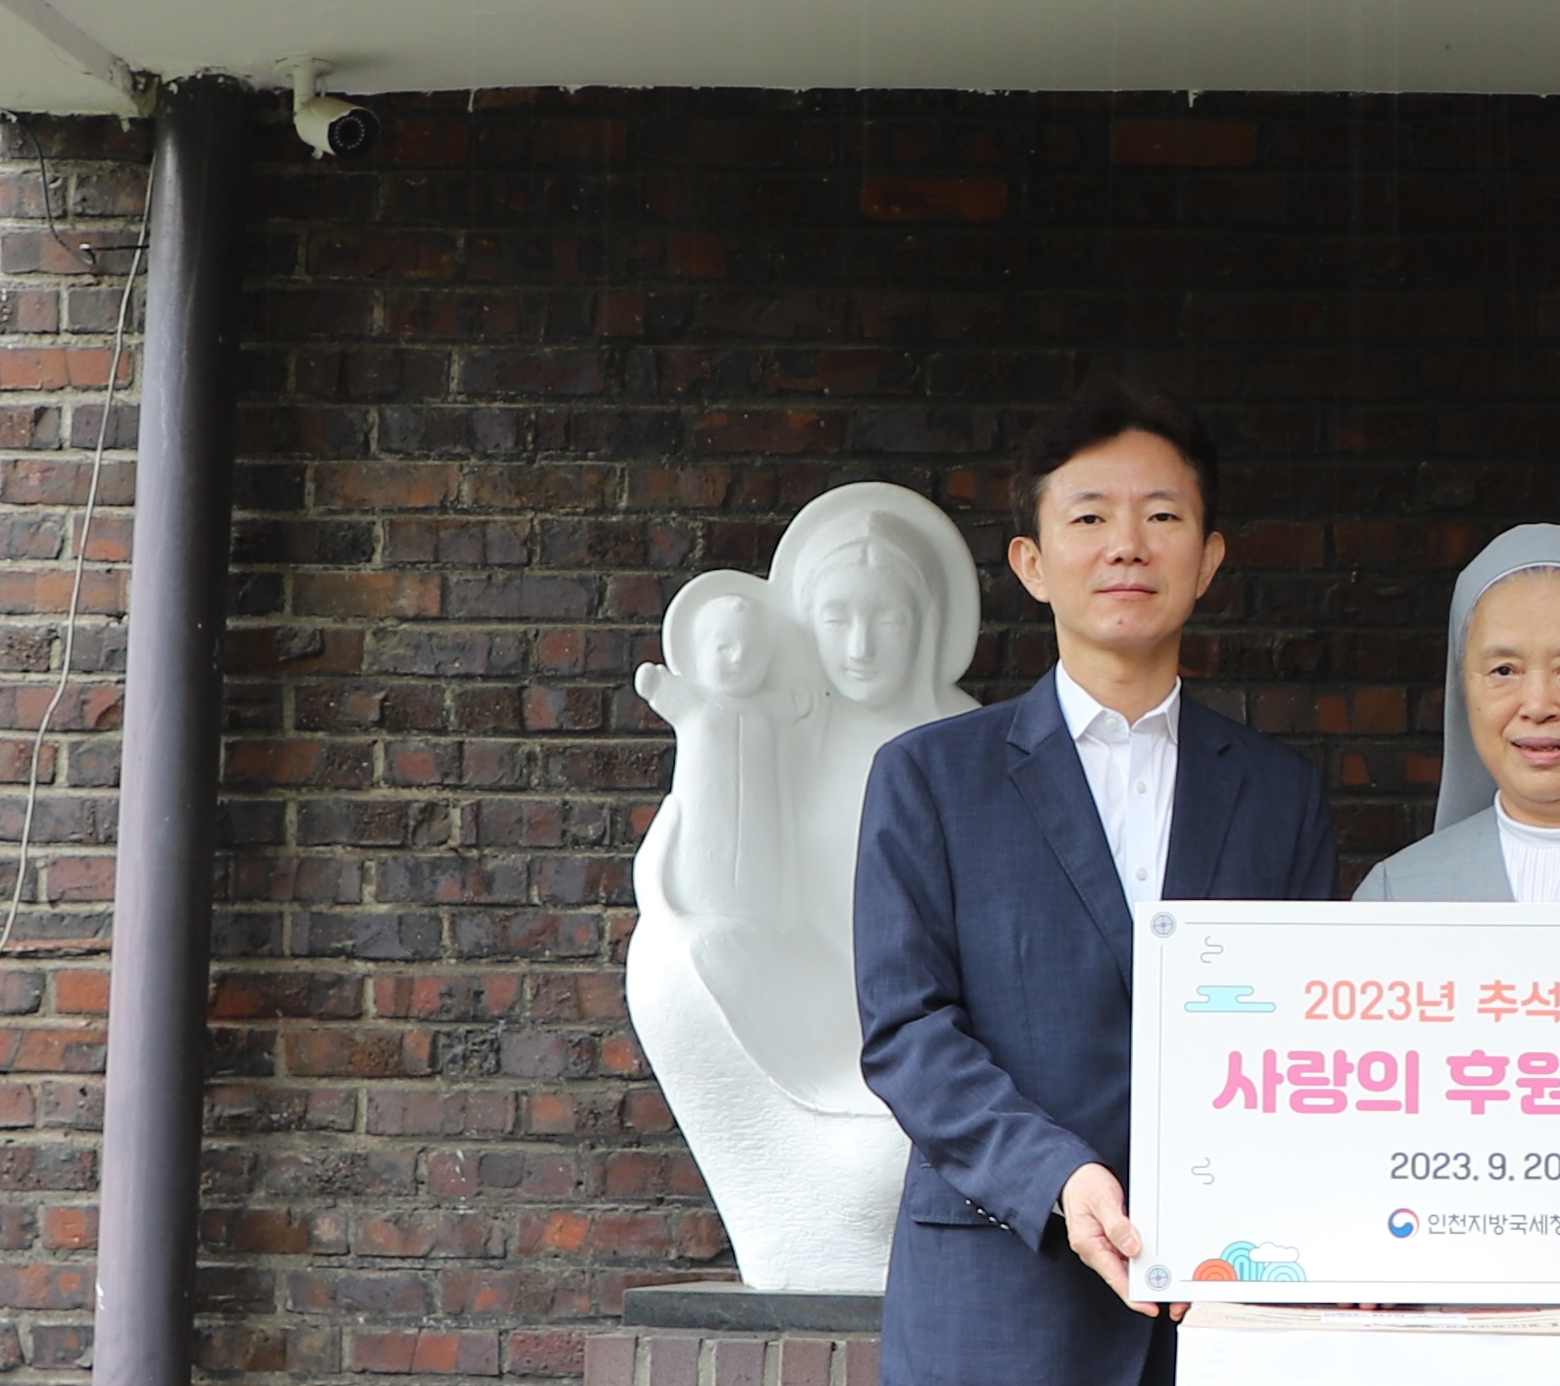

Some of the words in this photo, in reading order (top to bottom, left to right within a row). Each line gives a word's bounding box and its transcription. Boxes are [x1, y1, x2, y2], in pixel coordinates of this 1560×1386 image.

[1304, 980, 1456, 1023] 2023년
[1212, 1049, 1420, 1115] 사랑의
[1390, 1151, 1479, 1182] 2023.
[1487, 1152, 1515, 1182] 9.
